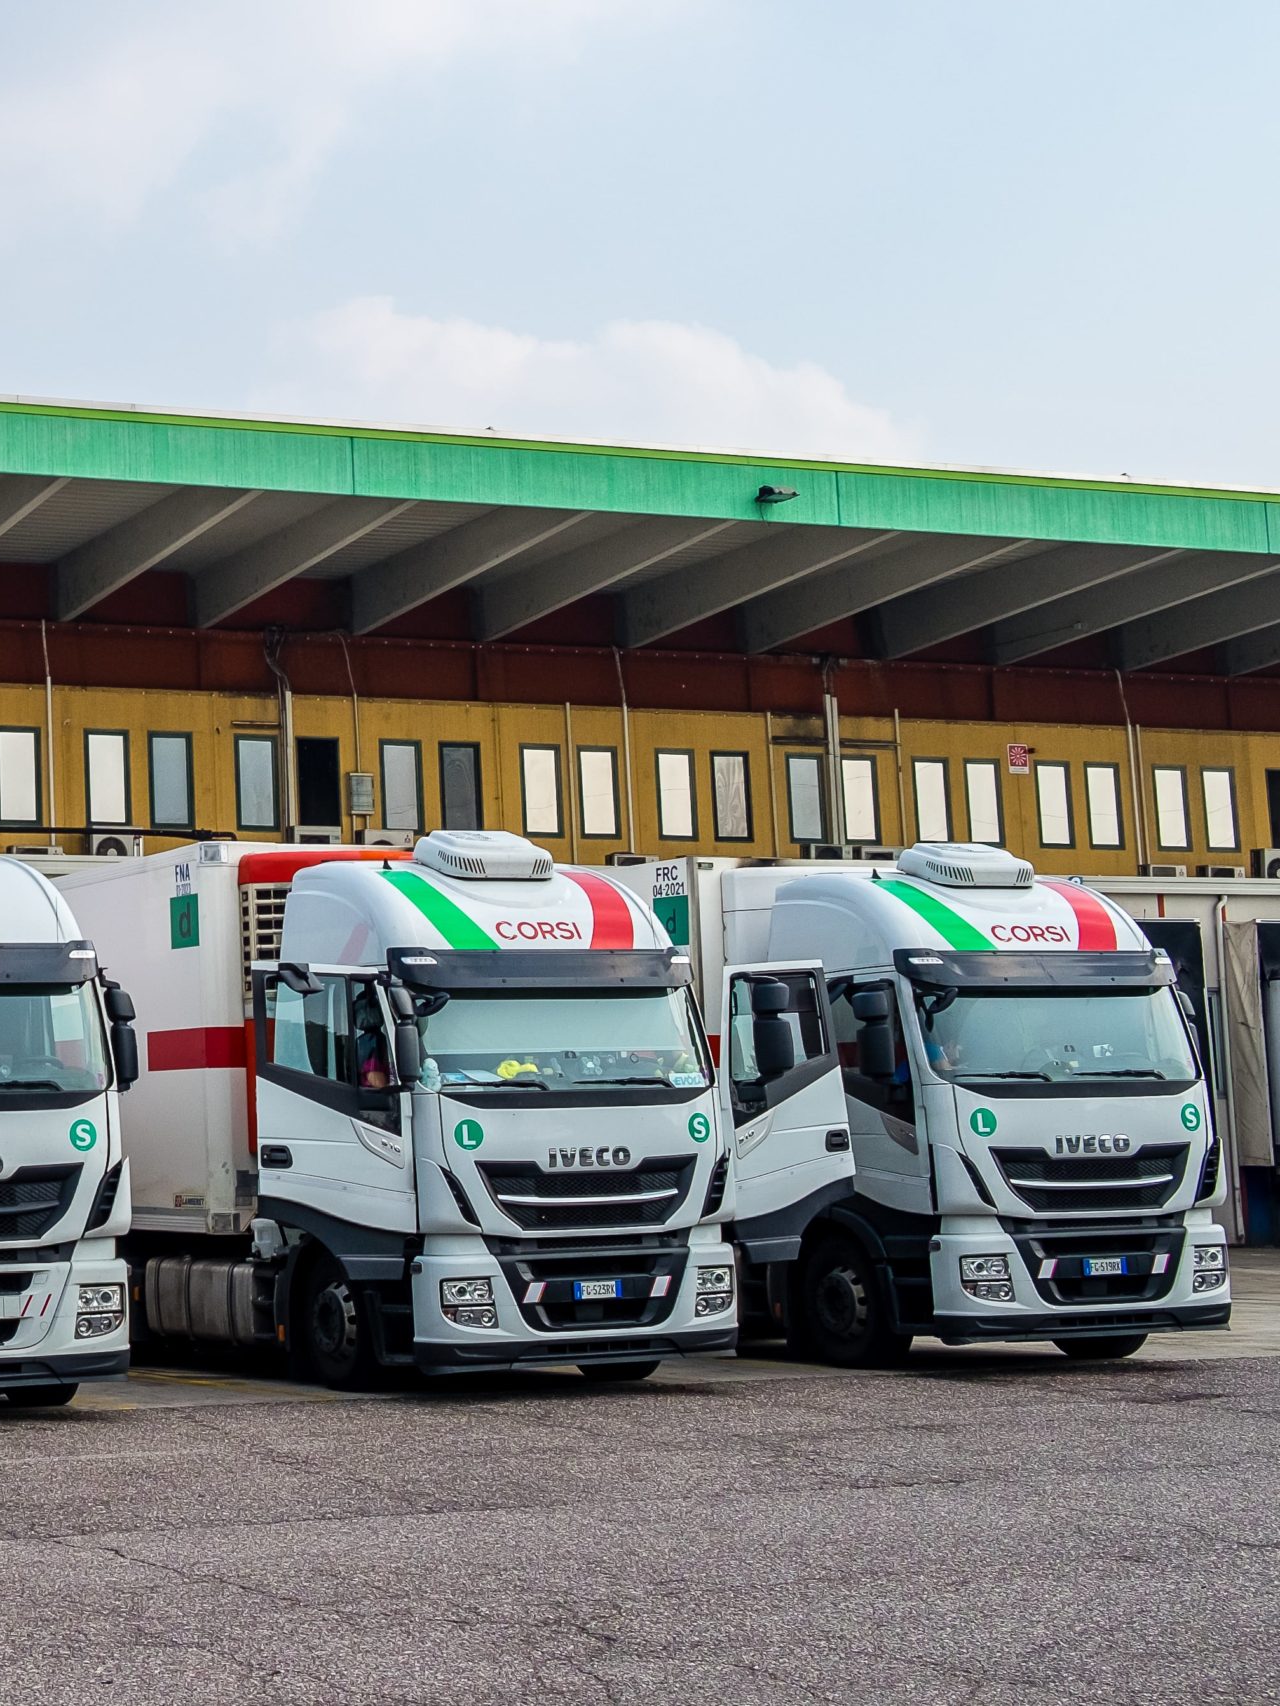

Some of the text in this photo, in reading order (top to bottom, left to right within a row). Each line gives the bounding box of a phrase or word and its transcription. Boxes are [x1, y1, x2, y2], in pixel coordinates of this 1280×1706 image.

[175, 863, 191, 882] FNA
[655, 865, 679, 882] FRC
[652, 881, 685, 897] 04-2021
[179, 901, 192, 939] d
[495, 920, 583, 941] CORSI
[665, 908, 677, 935] d
[990, 924, 1072, 943] CORSI
[692, 1117, 707, 1139] S
[976, 1112, 991, 1133] L
[1185, 1107, 1198, 1128] S
[75, 1123, 92, 1147] S
[462, 1124, 477, 1146] L
[1055, 1134, 1131, 1154] IVECO
[548, 1146, 632, 1168] IVECO
